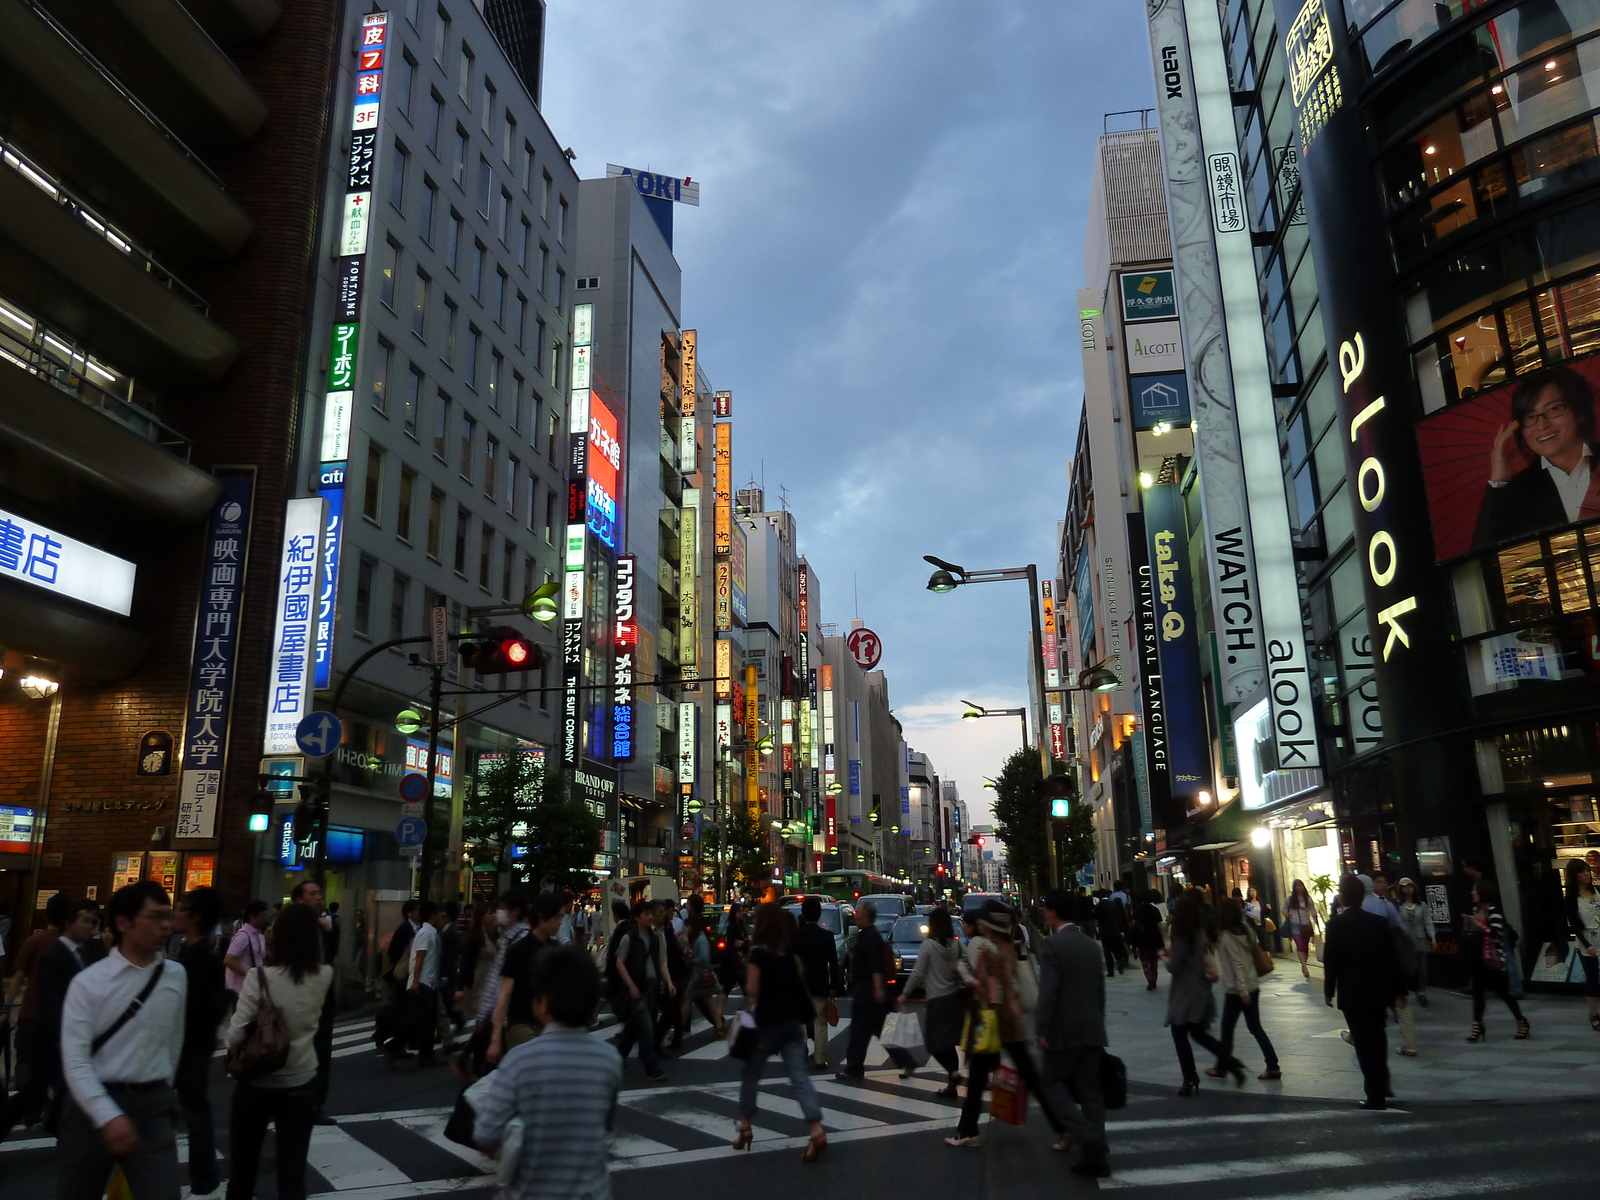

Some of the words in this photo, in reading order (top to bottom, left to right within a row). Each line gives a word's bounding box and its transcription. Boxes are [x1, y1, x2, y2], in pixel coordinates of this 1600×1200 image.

[359, 27, 384, 95] 皮フ科
[355, 111, 376, 123] 3F
[349, 136, 363, 188] コンタクト
[359, 133, 376, 186] プライス
[622, 168, 681, 202] OKI
[1213, 156, 1239, 229] 眼鏡市場
[349, 207, 362, 246] 献血ルーム
[346, 261, 359, 316] FONTAINE
[1127, 296, 1173, 307] 淳久堂書店
[1080, 309, 1101, 352] ALCOTT
[1134, 338, 1177, 356] ALCOTT
[321, 470, 344, 485] citi
[1339, 331, 1417, 663] alook
[569, 483, 577, 519] union
[719, 567, 728, 595] 270
[1155, 530, 1185, 642] taka-Q
[272, 534, 315, 714] 紀伊國屋書店
[564, 623, 572, 664] コンタクト
[572, 622, 581, 663] プライス
[1104, 557, 1116, 614] SHINJUKU
[1110, 619, 1123, 693] MITSUKOSHI
[191, 538, 240, 765] 映画専門大学院大学
[1138, 565, 1156, 665] UNIVERSAL
[1148, 675, 1166, 771] LANGUAGE
[567, 676, 576, 694] THE
[1268, 639, 1315, 765] alook
[566, 696, 575, 716] SUIT
[564, 719, 575, 763] COMPANY
[749, 735, 757, 778] Matsuoto
[1134, 740, 1146, 782] DIAMOND
[208, 772, 218, 794] 映画
[574, 770, 600, 789] BRAND
[601, 779, 615, 793] OFF
[585, 786, 605, 798] TOKYO
[1175, 774, 1201, 782] タカキュー
[177, 803, 192, 836] 研究科
[189, 773, 207, 834] プロデュース
[281, 821, 293, 858] citibank
